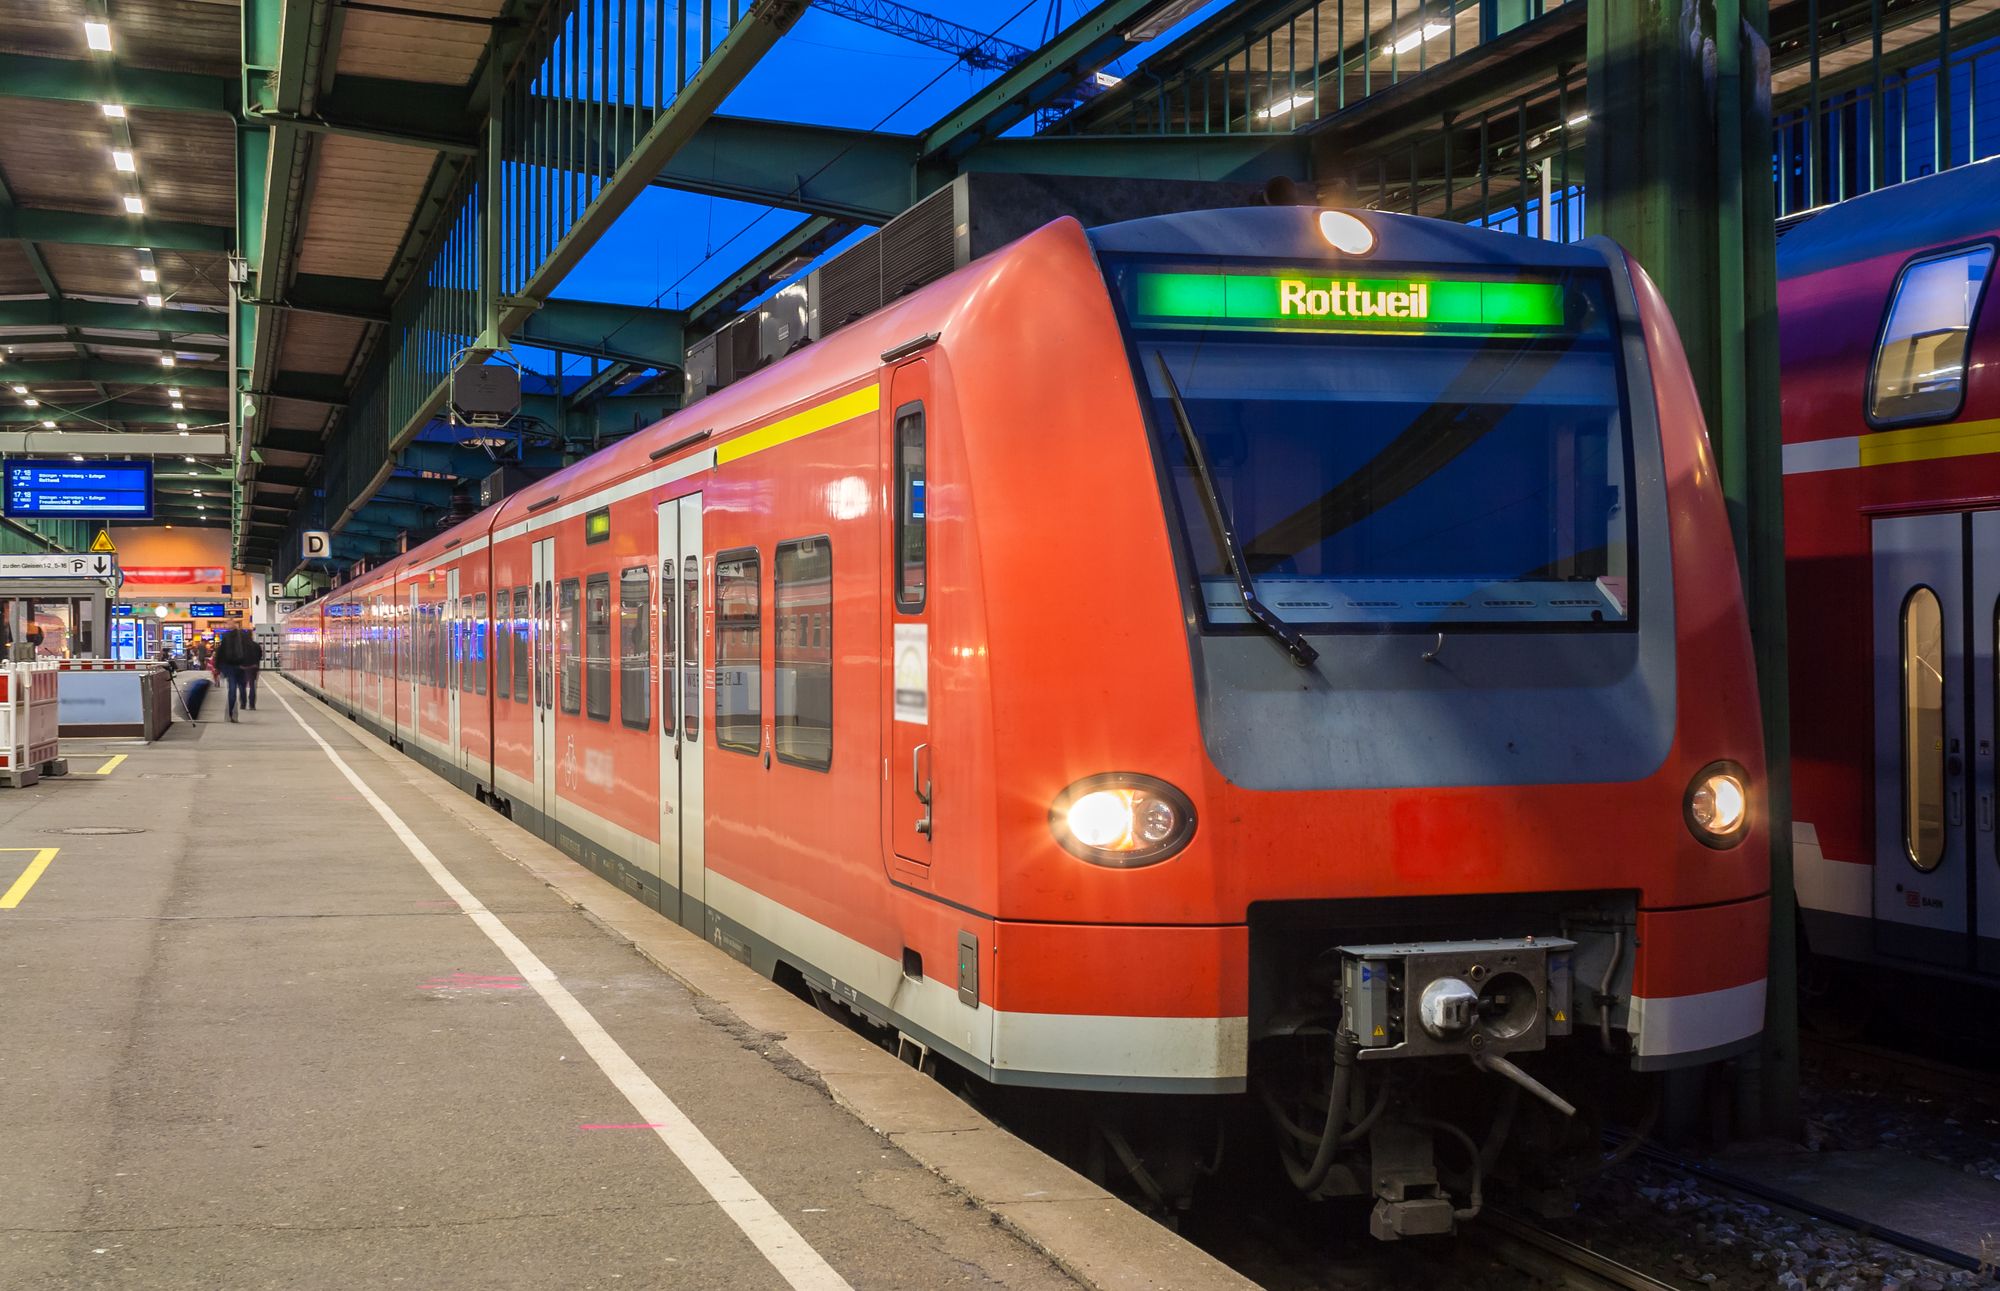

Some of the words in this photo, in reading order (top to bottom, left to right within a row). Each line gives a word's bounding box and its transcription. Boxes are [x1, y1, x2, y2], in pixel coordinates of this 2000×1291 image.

[1280, 279, 1428, 318] Rottweil
[308, 536, 323, 552] D
[74, 562, 83, 573] P
[272, 585, 280, 595] E
